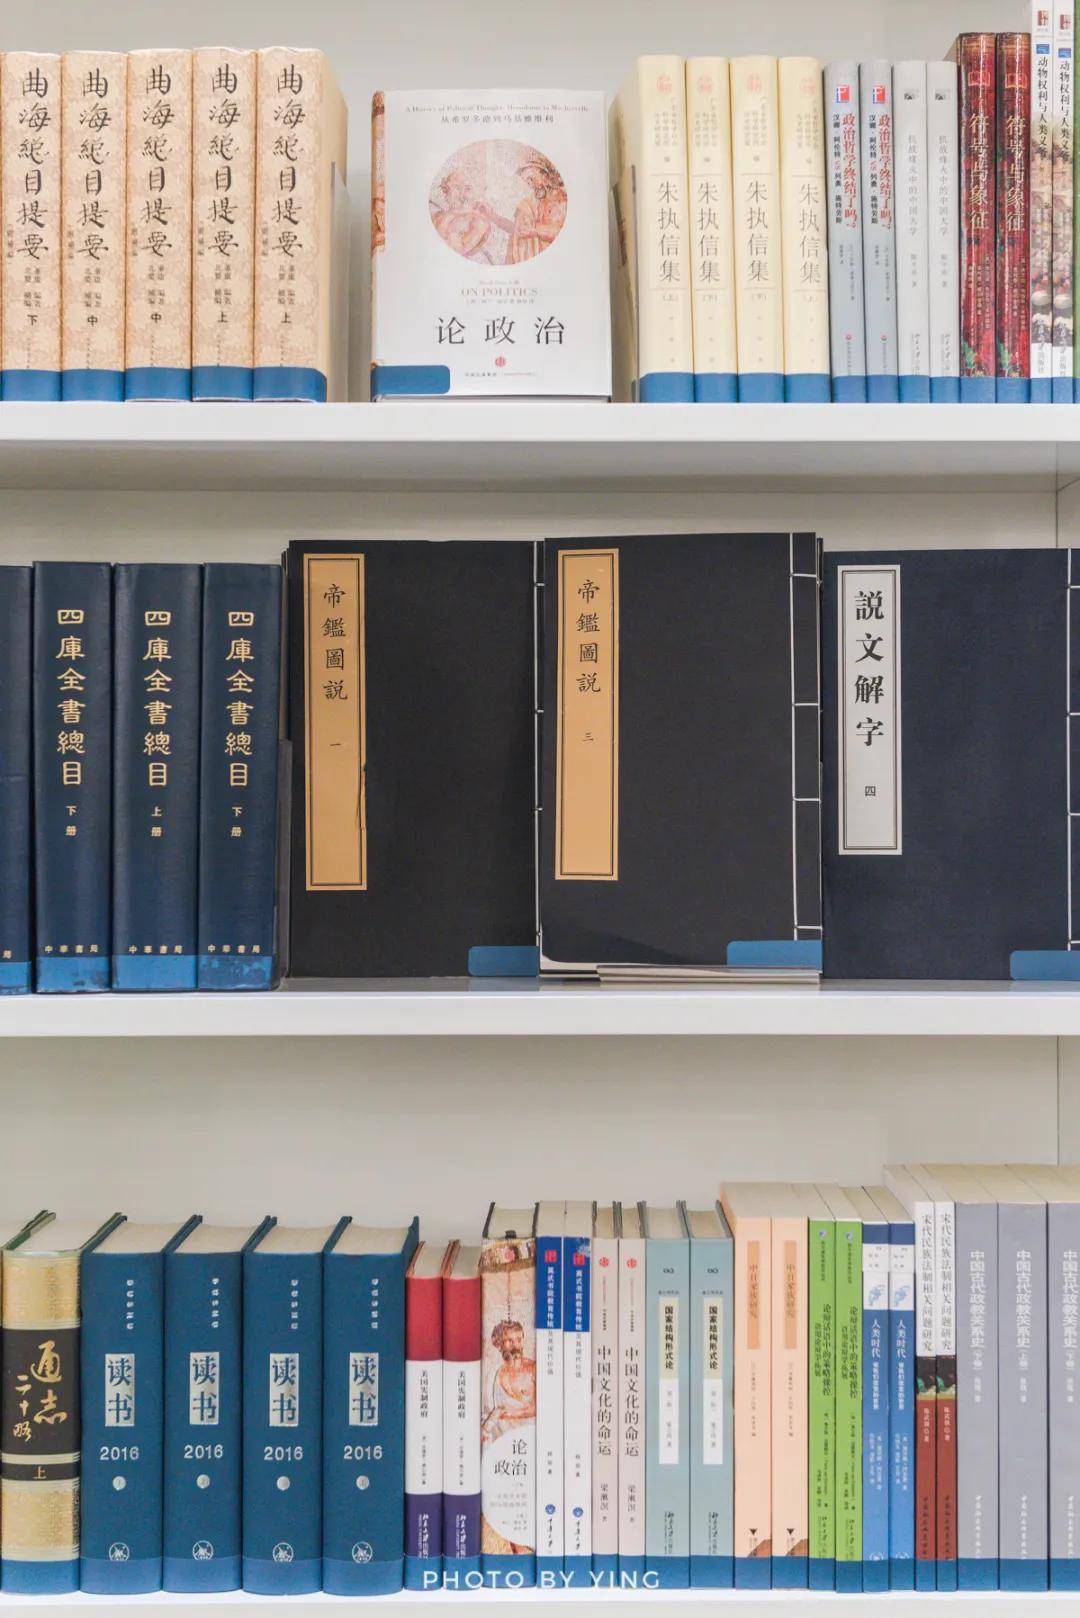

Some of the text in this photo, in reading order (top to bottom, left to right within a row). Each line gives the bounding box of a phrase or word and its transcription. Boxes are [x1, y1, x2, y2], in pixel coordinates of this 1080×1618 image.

[969, 113, 989, 230] 符号与象征
[1006, 115, 1026, 231] 符号与象征
[657, 181, 681, 283] 朱执信集
[697, 181, 720, 283] 朱执信集
[746, 181, 770, 282] 朱执信集
[799, 183, 821, 284] 朱执信集
[461, 288, 538, 296] ON POLITICS
[27, 314, 38, 326] 下
[87, 315, 98, 327] 中
[150, 312, 162, 324] 中
[217, 312, 228, 323] 上
[281, 312, 292, 324] 上
[436, 316, 564, 344] 论政治
[55, 609, 86, 786] 四庫全書總目
[142, 611, 173, 787] 四庫全書總目
[225, 611, 256, 787] 四庫全書總目
[582, 732, 594, 742] 三
[865, 786, 876, 797] 四
[65, 805, 78, 837] 下册
[150, 805, 163, 838] 上册
[230, 806, 243, 837] 下册
[2, 950, 12, 959] 局
[44, 944, 98, 953] 中華書局
[128, 945, 182, 954] 中華書局
[208, 944, 261, 954] 中華書局
[969, 1250, 985, 1348] 中国古代政教关系史
[1016, 1250, 1031, 1348] 中国古代政教关系史
[1063, 1250, 1079, 1348] 中国古代政教关系史
[664, 1306, 674, 1370] 国家结构形式论
[709, 1306, 718, 1370] 国家结构形式论
[871, 1319, 881, 1358] 人类时代
[896, 1319, 906, 1358] 人类时代
[107, 1356, 133, 1424] 读书
[192, 1355, 217, 1423] 读书
[272, 1356, 297, 1423] 读书
[352, 1356, 377, 1422] 读书
[597, 1346, 611, 1456] 中国文化的命运
[625, 1347, 639, 1457] 中国文化的命运
[100, 1446, 139, 1461] 2016
[184, 1445, 223, 1460] 2016
[264, 1446, 303, 1461] 2016
[344, 1446, 383, 1460] 2016
[512, 1439, 527, 1455] 论
[33, 1466, 47, 1480] 上
[494, 1460, 527, 1476] 政治
